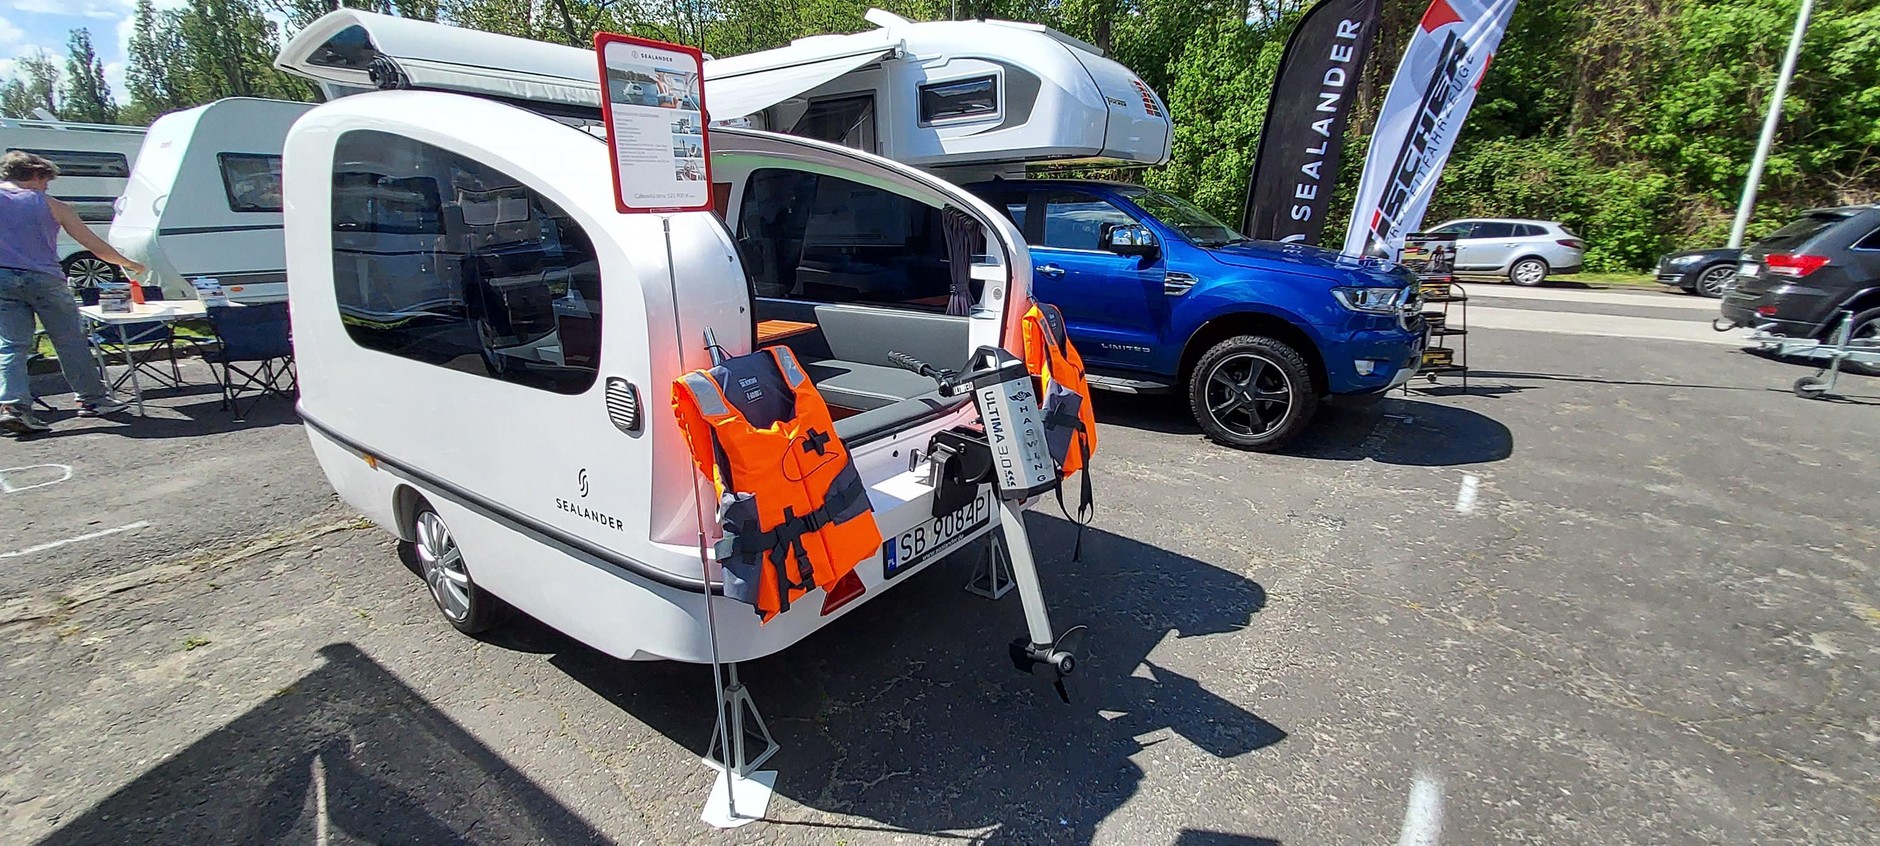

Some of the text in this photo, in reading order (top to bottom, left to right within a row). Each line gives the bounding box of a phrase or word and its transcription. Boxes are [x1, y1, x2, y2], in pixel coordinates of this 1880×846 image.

[640, 53, 673, 62] SEALANDER
[1290, 19, 1361, 222] SEALANDER
[1101, 343, 1151, 353] LIMITED
[984, 391, 1005, 443] ULTIMA
[998, 446, 1012, 469] 3.0
[556, 498, 624, 532] SEALANDER
[901, 496, 985, 562] SB 9084P
[887, 558, 896, 568] PL
